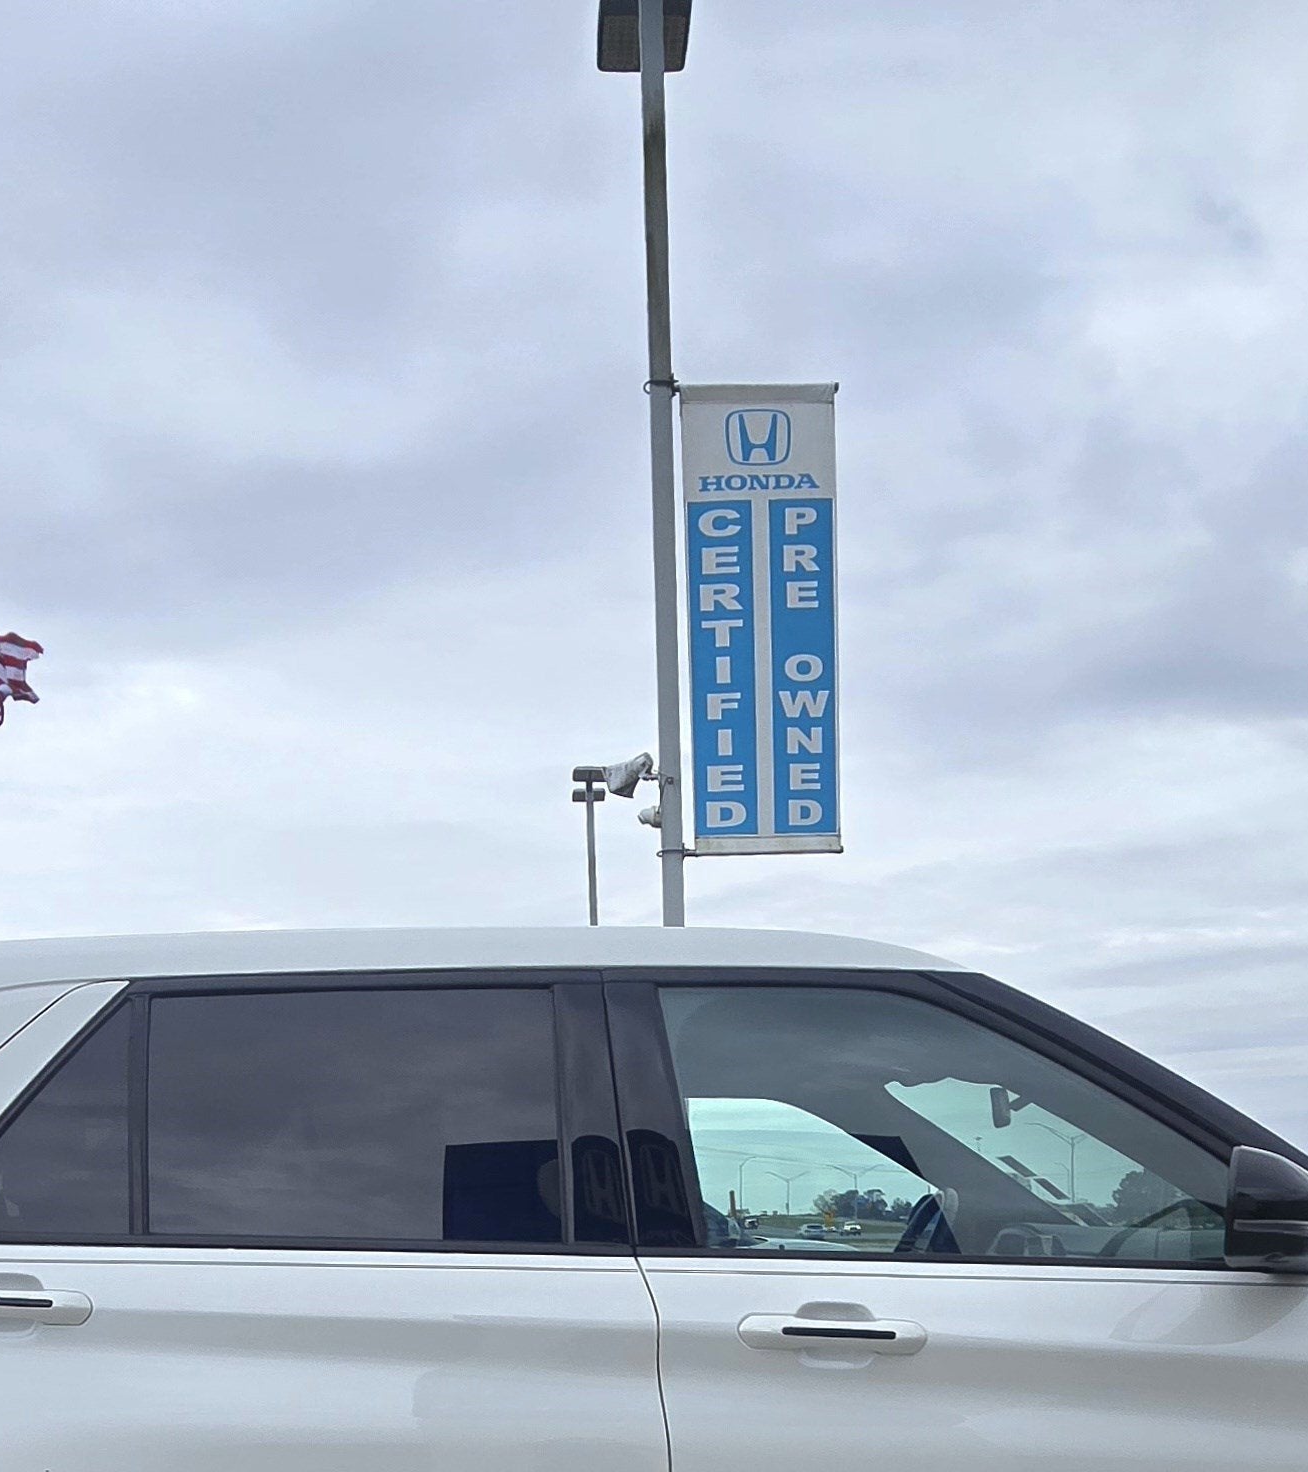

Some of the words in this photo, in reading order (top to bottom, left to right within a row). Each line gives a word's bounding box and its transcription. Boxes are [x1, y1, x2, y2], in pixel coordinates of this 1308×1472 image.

[698, 473, 820, 492] HONDA
[782, 507, 821, 609] PRE
[697, 508, 747, 828] CERTIFIED
[779, 653, 829, 827] OWNED
